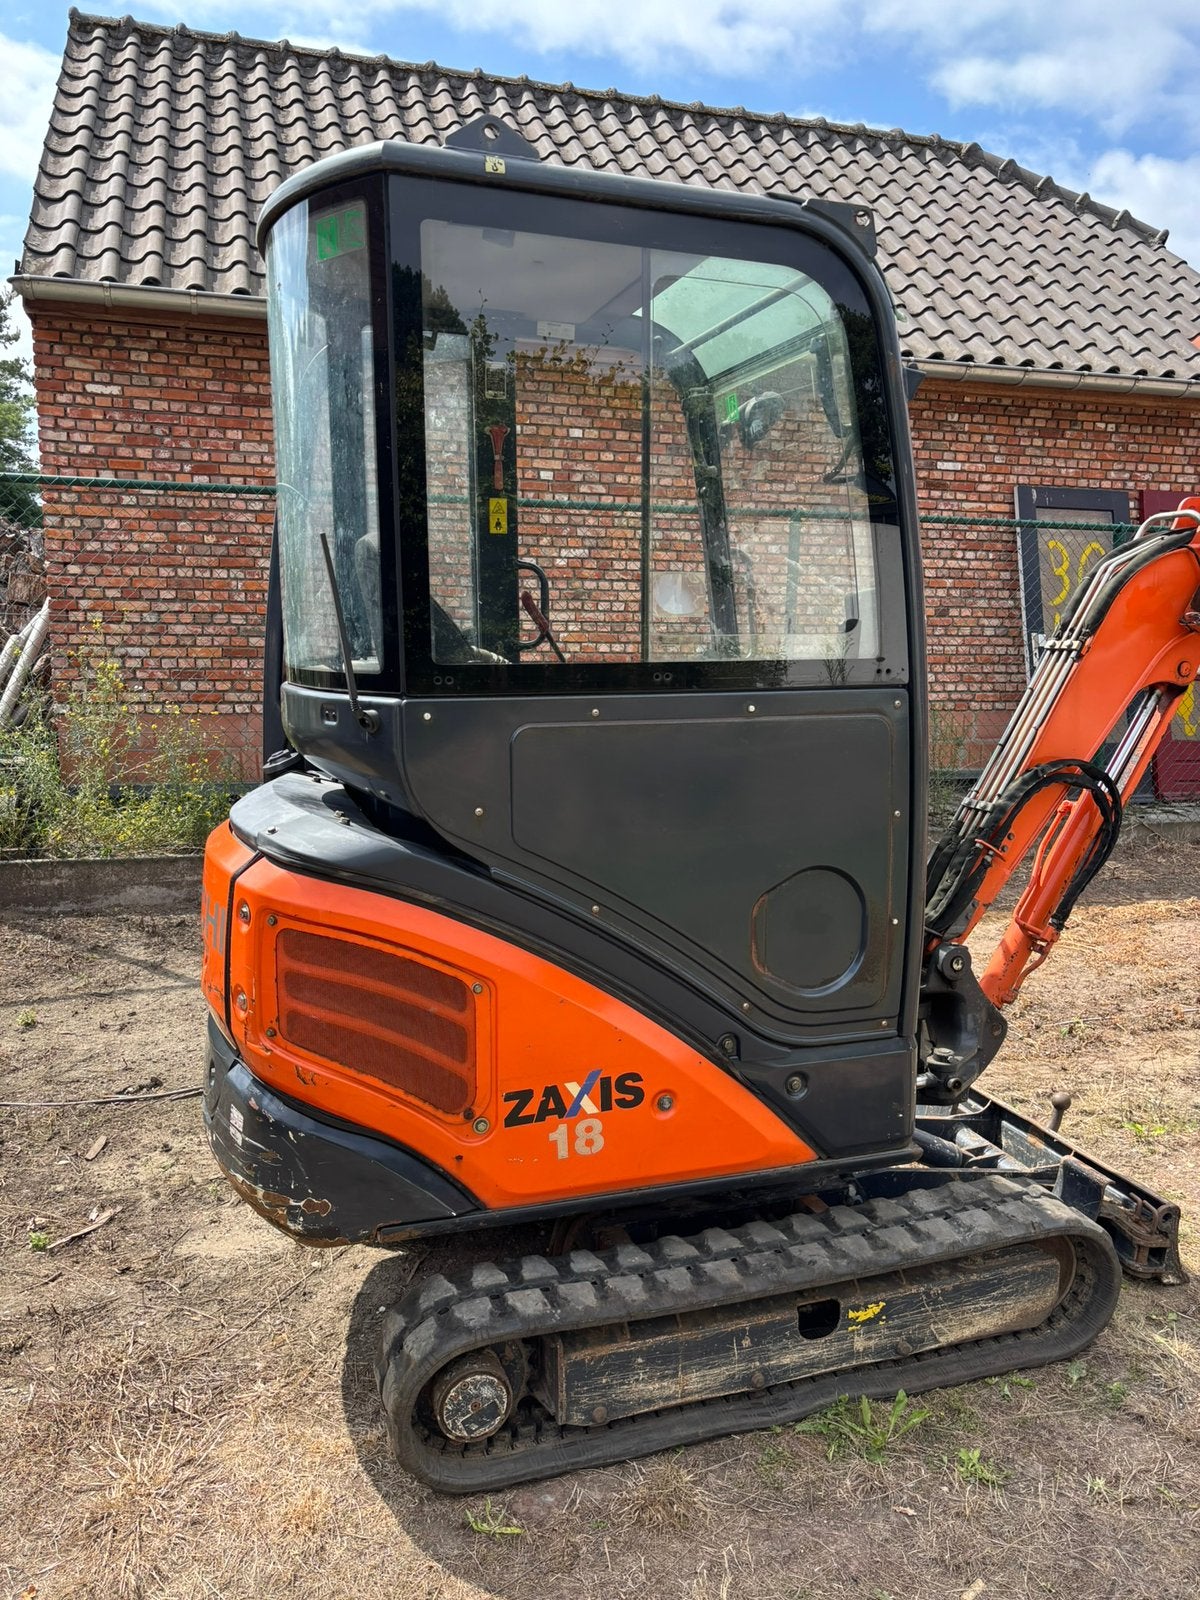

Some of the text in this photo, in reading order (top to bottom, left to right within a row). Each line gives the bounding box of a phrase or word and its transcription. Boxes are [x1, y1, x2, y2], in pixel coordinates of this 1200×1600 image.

[203, 889, 226, 956] HI
[503, 1069, 645, 1128] ZAXIS
[548, 1118, 605, 1160] 18
